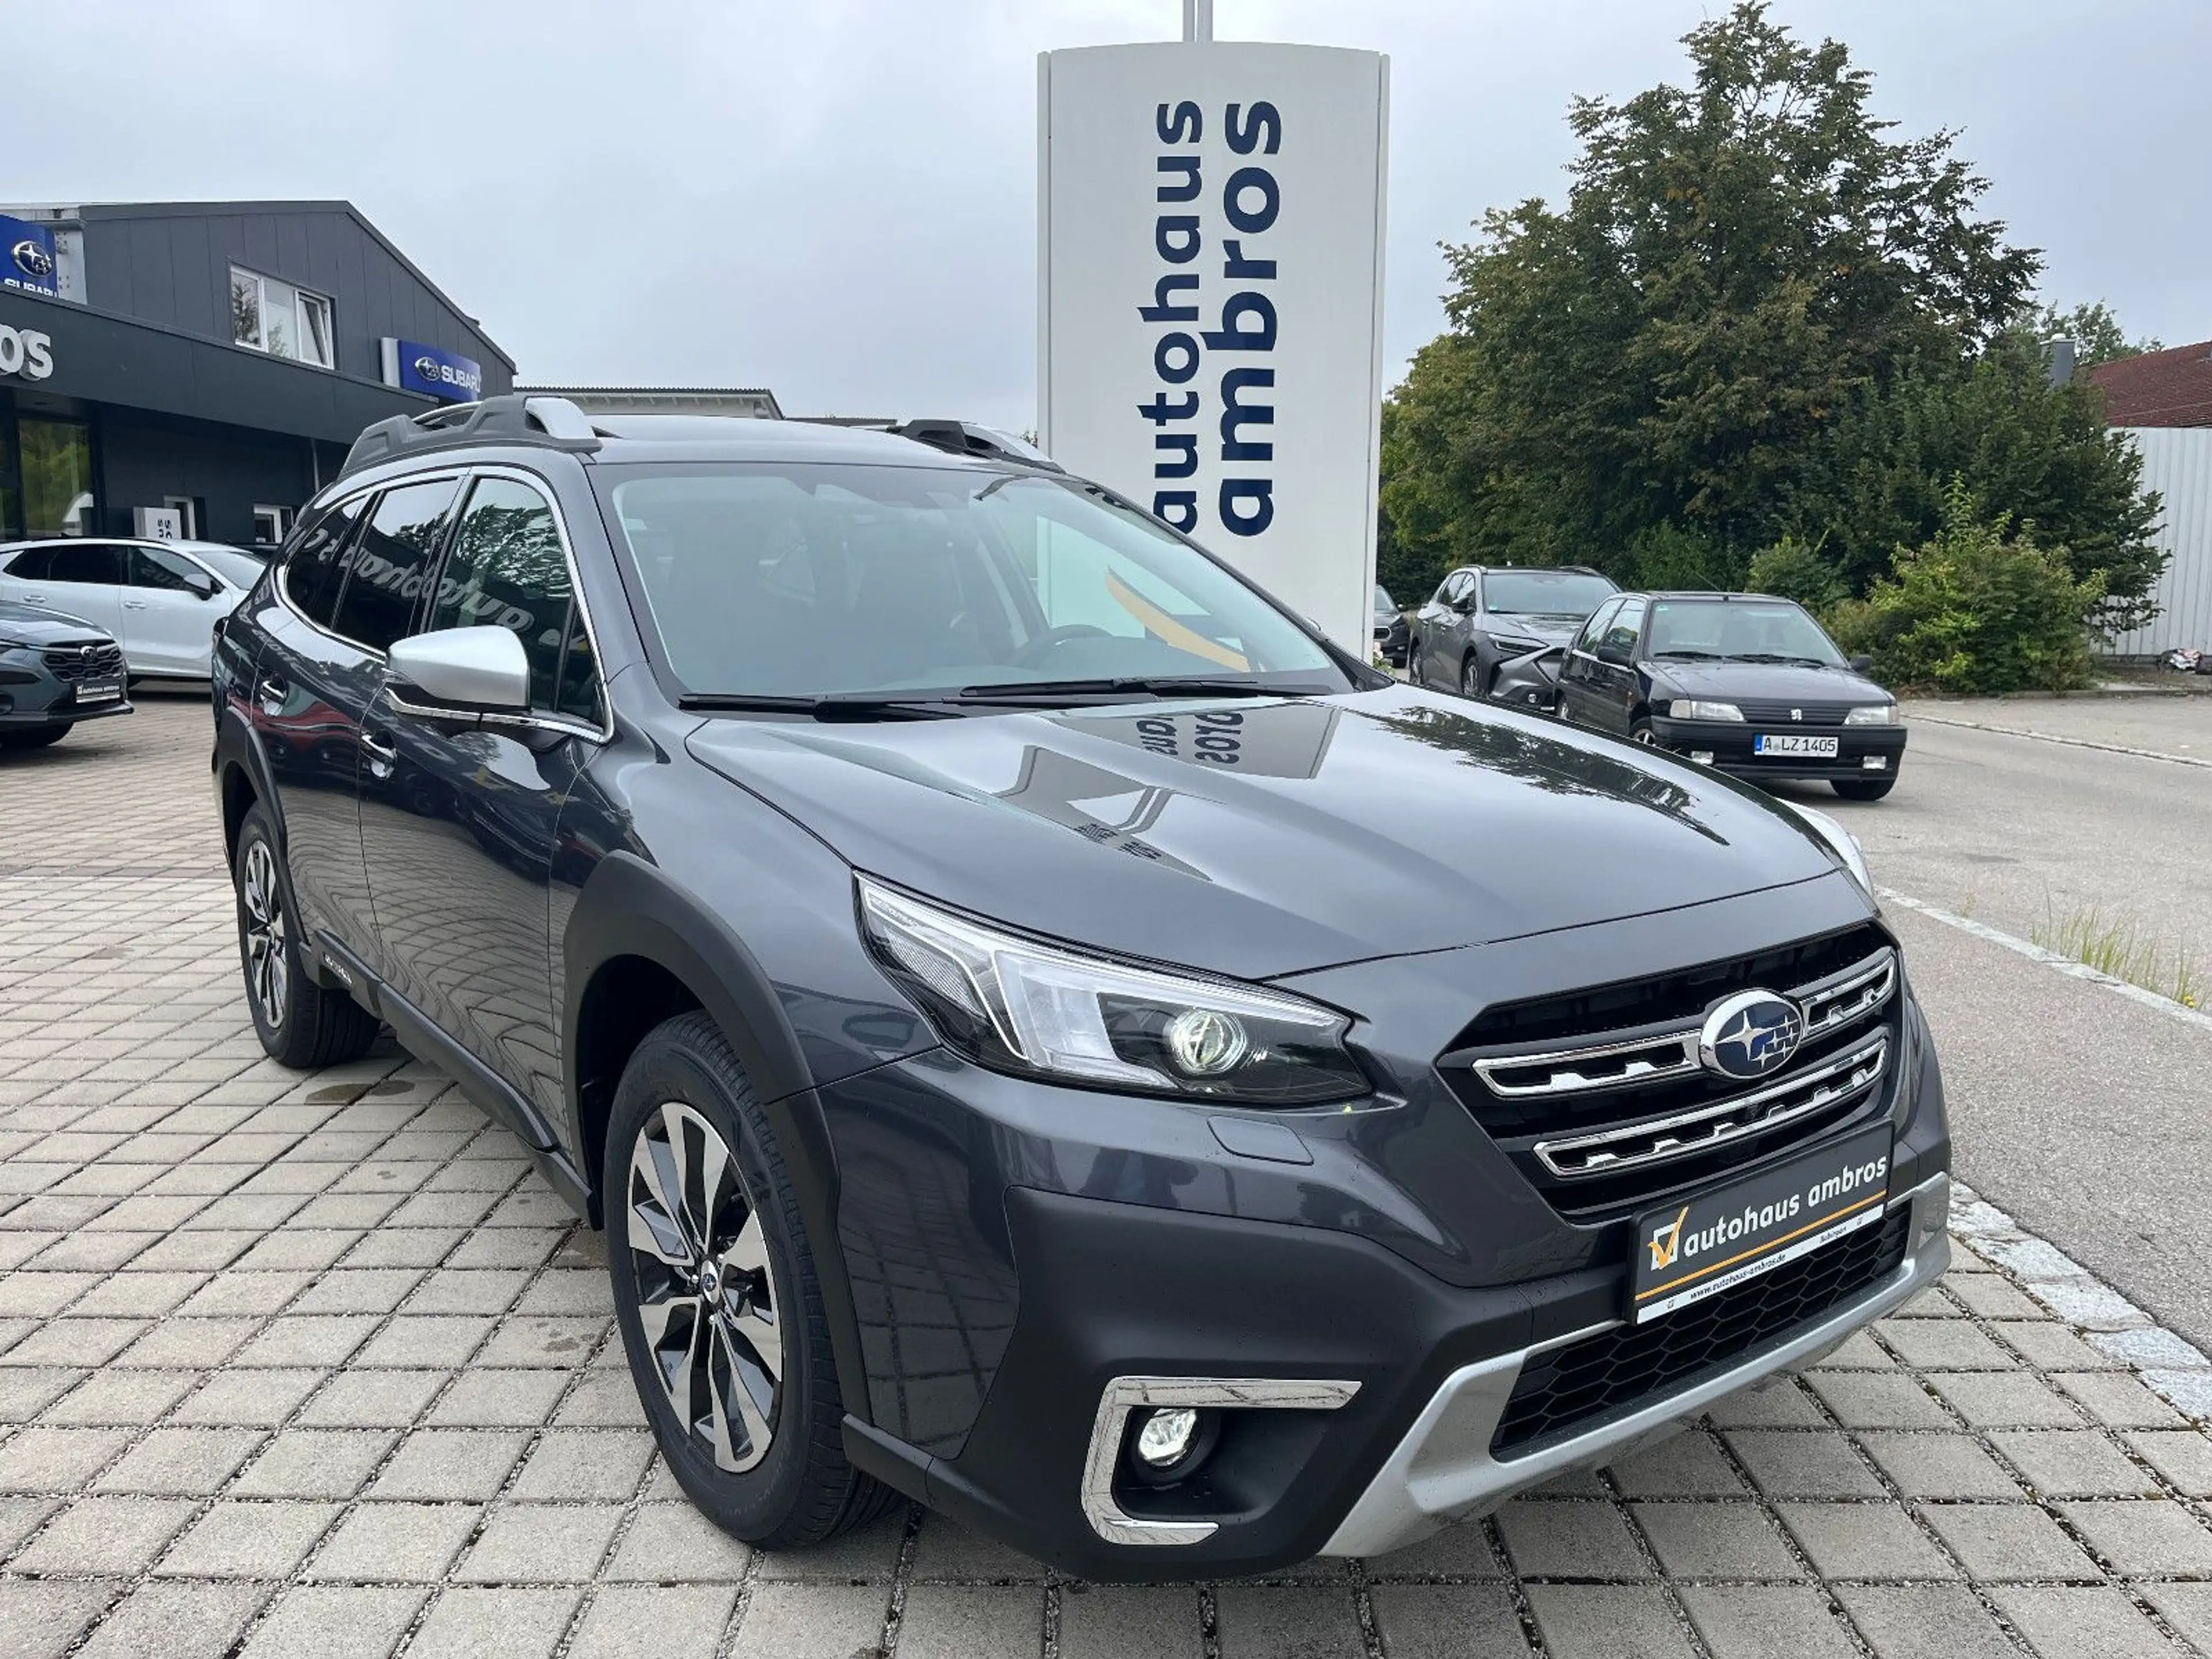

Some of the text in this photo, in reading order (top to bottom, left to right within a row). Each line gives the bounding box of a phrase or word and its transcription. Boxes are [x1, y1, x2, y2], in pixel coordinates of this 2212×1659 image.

[1137, 100, 1202, 535] autohaus
[1199, 100, 1281, 536] ambros
[441, 365, 482, 392] SUBARU
[1764, 737, 1772, 750] A
[1801, 738, 1836, 751] 1405
[1684, 1156, 1887, 1256] autohaus ambros
